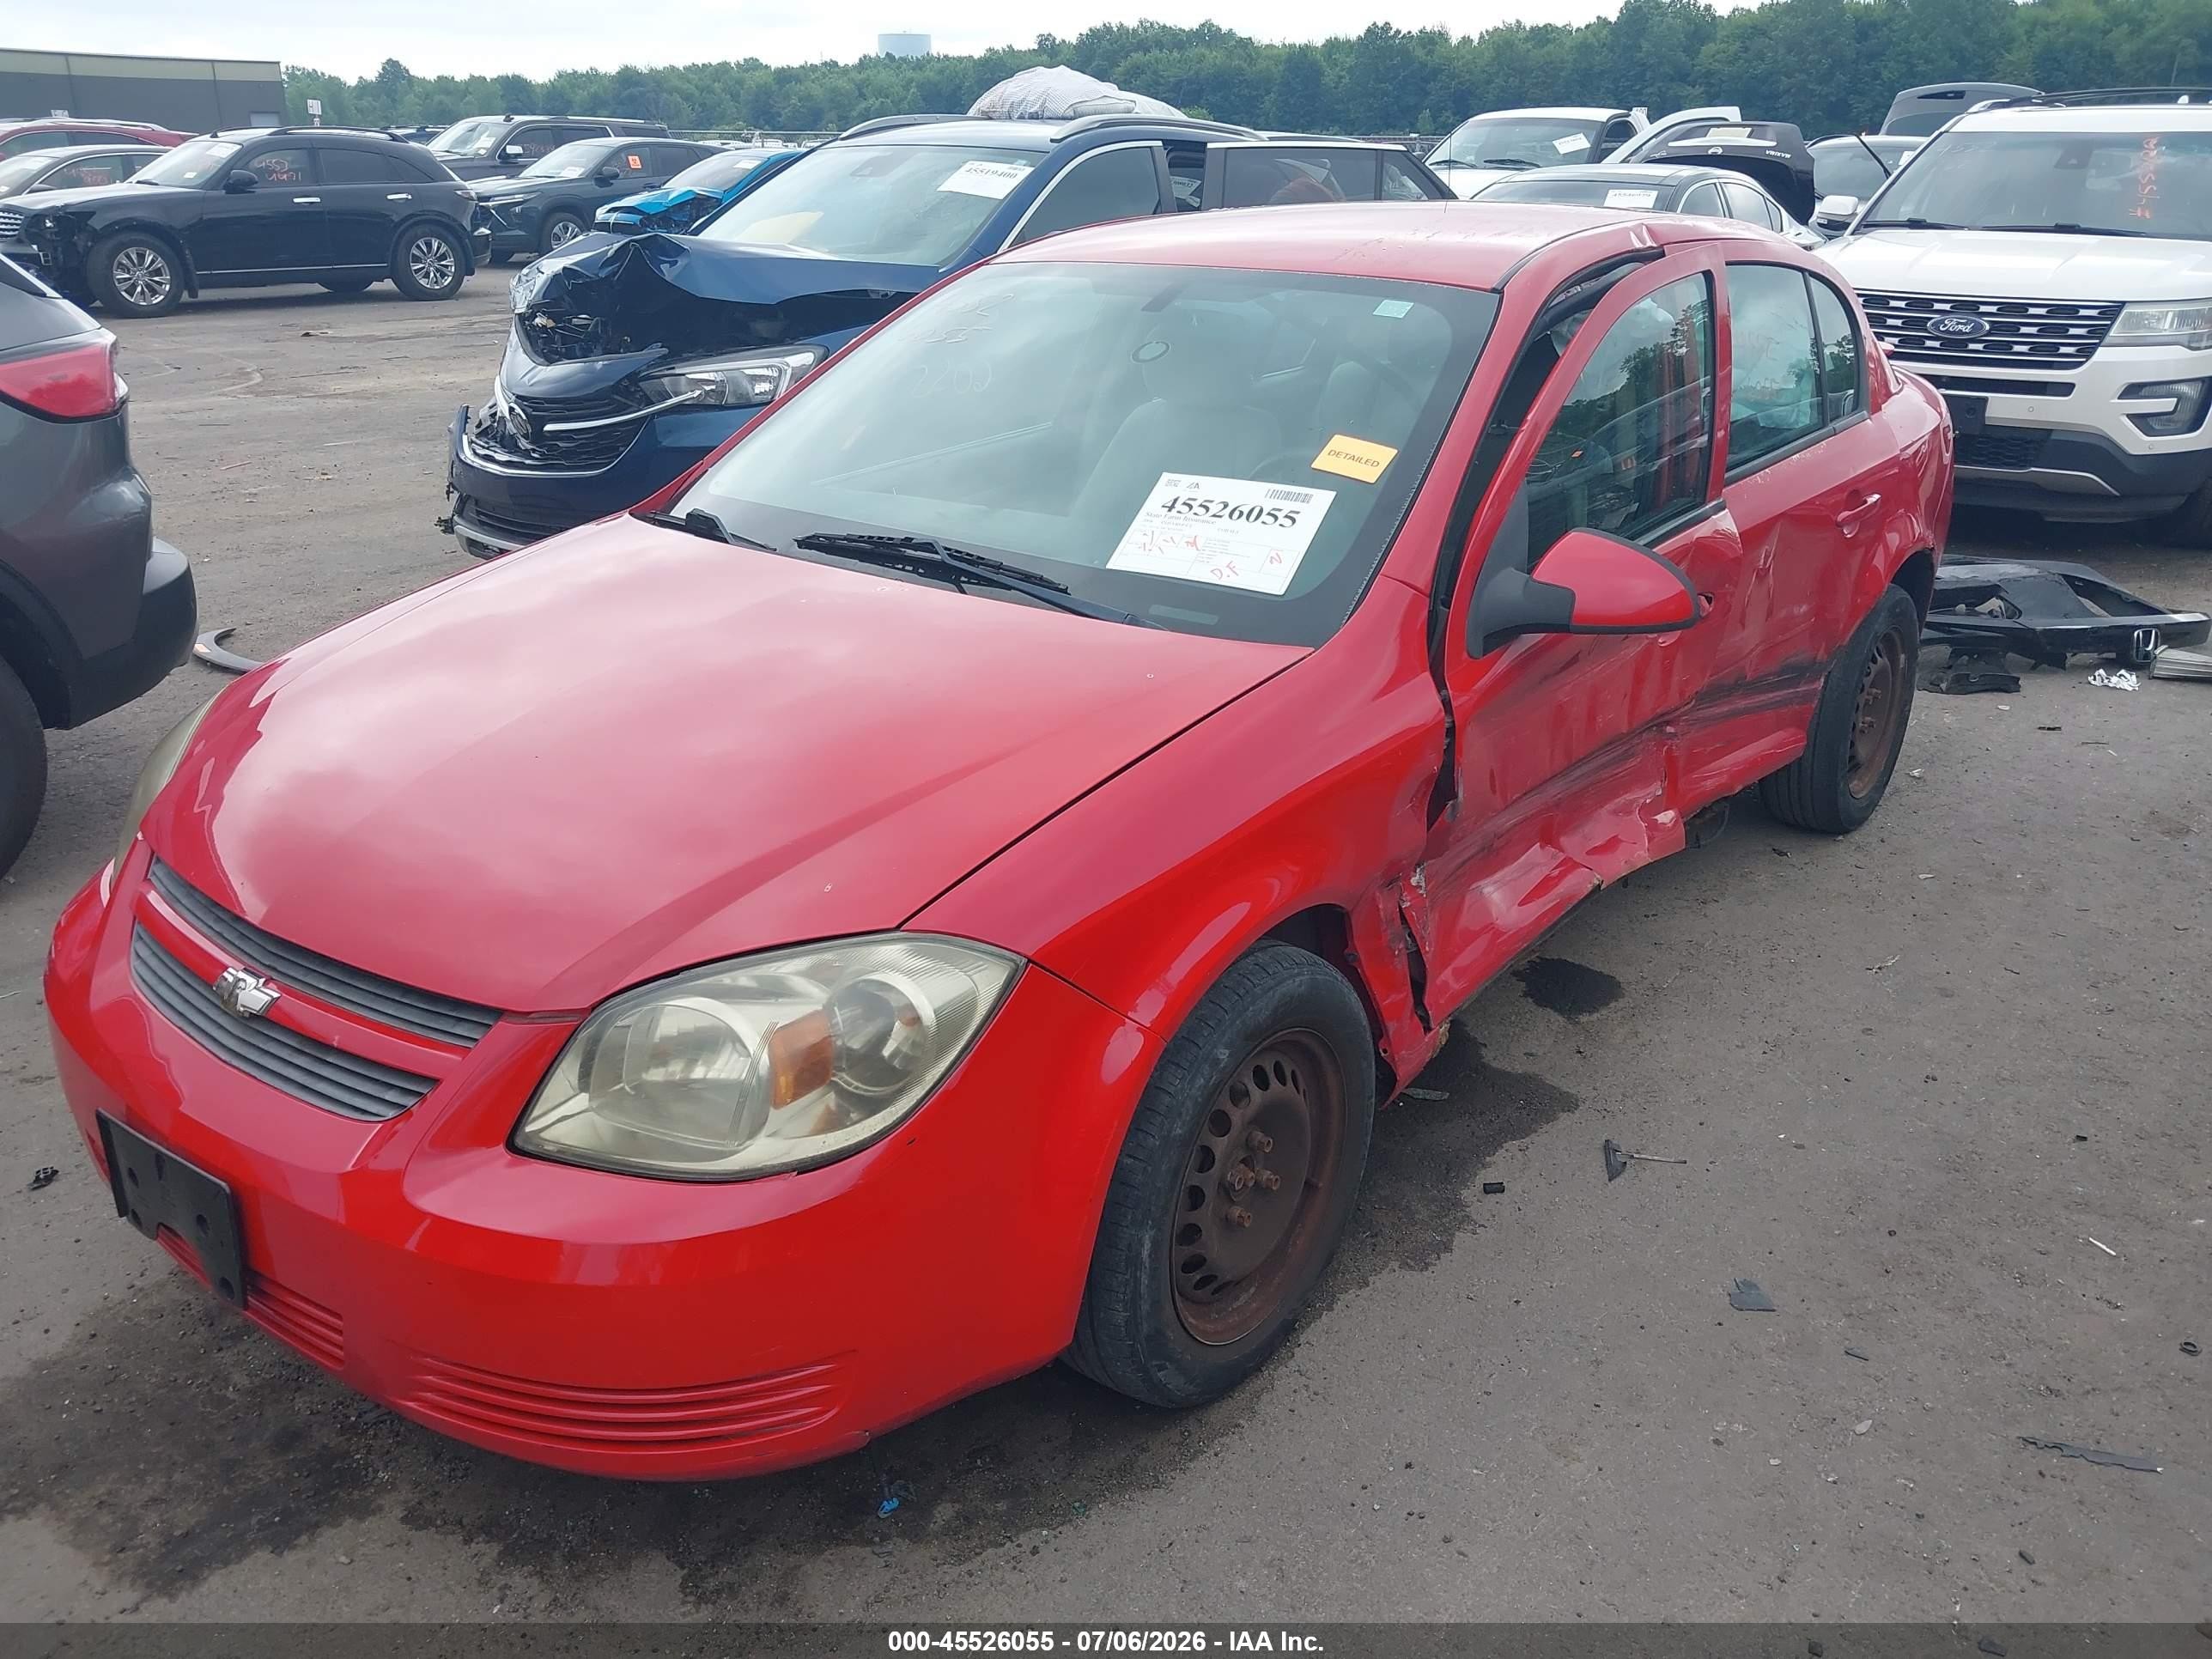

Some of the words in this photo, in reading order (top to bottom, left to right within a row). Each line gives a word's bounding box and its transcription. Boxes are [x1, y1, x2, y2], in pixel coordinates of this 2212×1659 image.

[1939, 318, 1975, 332] Ford
[1328, 449, 1380, 468] DETAILED
[1161, 495, 1301, 529] 45526055
